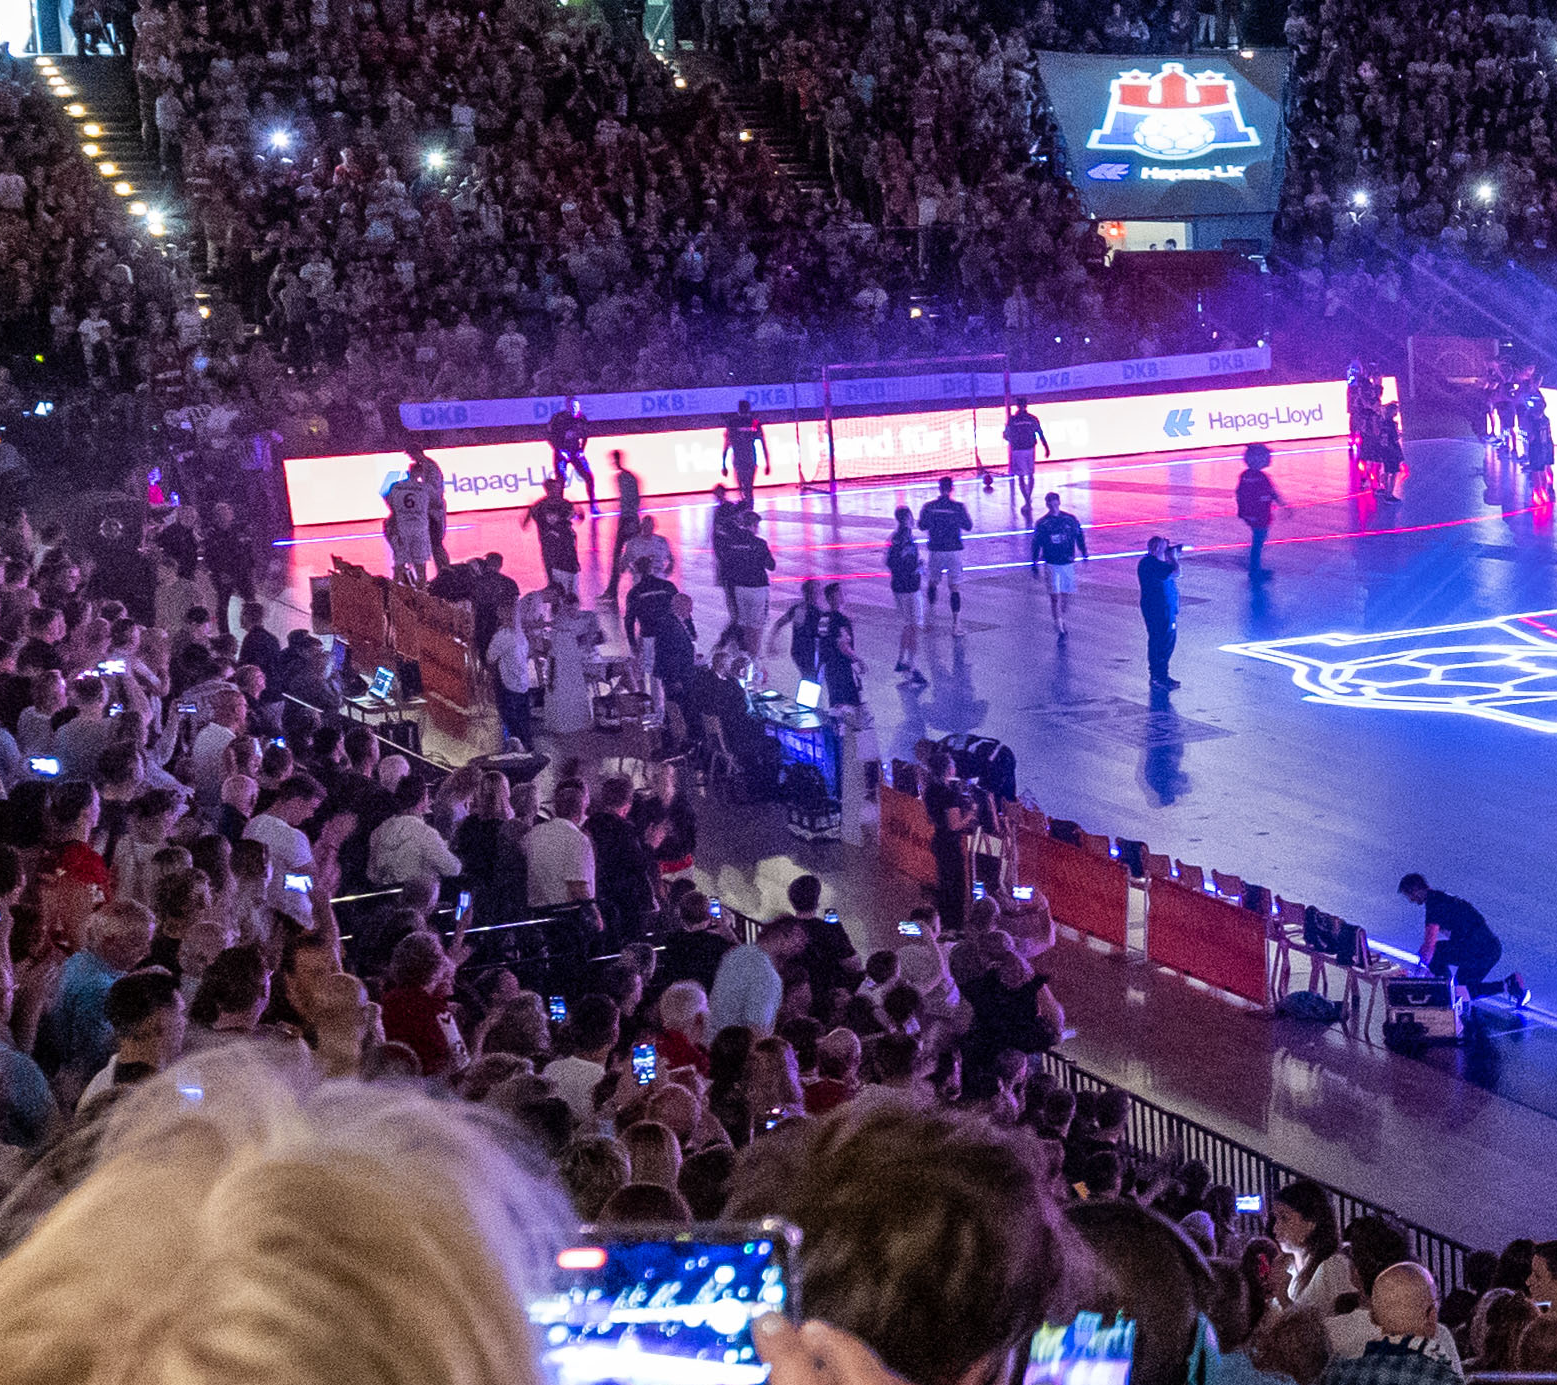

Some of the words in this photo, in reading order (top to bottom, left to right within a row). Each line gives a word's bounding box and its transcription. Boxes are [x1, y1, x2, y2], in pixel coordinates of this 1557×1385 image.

[1122, 361, 1159, 380] DKB
[1209, 354, 1244, 372] DKB
[1035, 371, 1071, 390] DKB
[642, 392, 685, 414] DKB
[746, 388, 788, 407] DKB
[419, 406, 469, 427] DKB
[533, 399, 567, 419] DK
[1208, 403, 1323, 432] Hapag-Lloyd
[402, 492, 416, 510] 6
